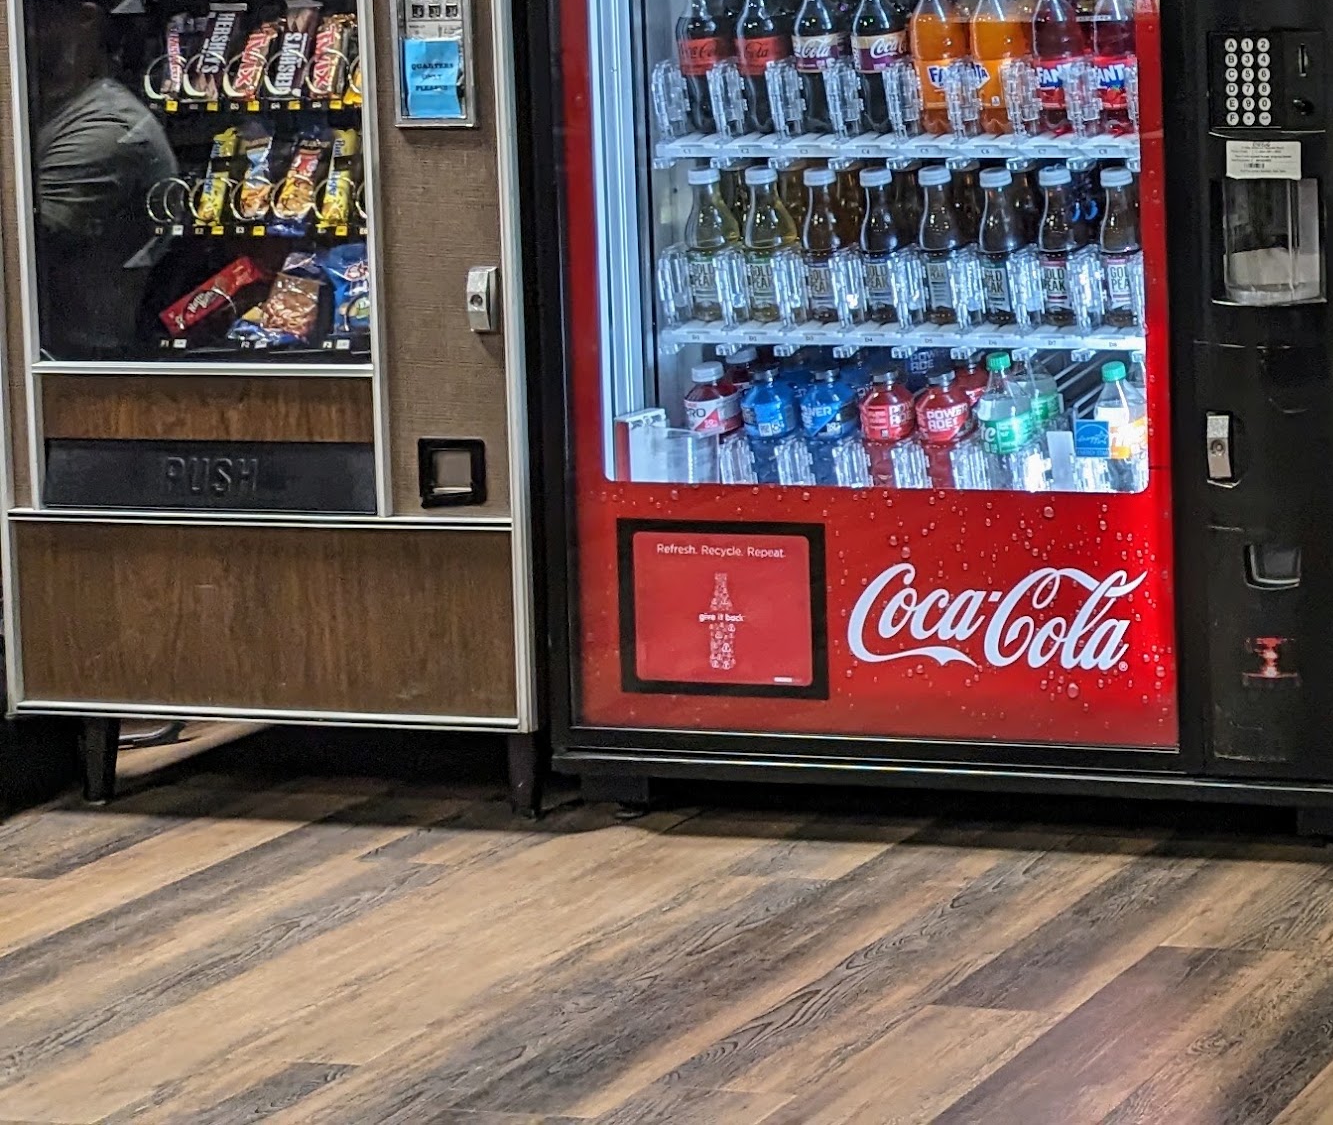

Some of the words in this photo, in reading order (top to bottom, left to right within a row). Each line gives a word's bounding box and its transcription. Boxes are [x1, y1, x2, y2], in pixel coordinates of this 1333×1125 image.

[926, 403, 968, 420] POWER
[163, 457, 259, 492] PUSH
[656, 544, 698, 555] Refresh.
[701, 545, 744, 557] Recycle.
[747, 546, 787, 559] Repeat.
[698, 613, 716, 623] give
[847, 562, 1149, 671] Coca-Cola
